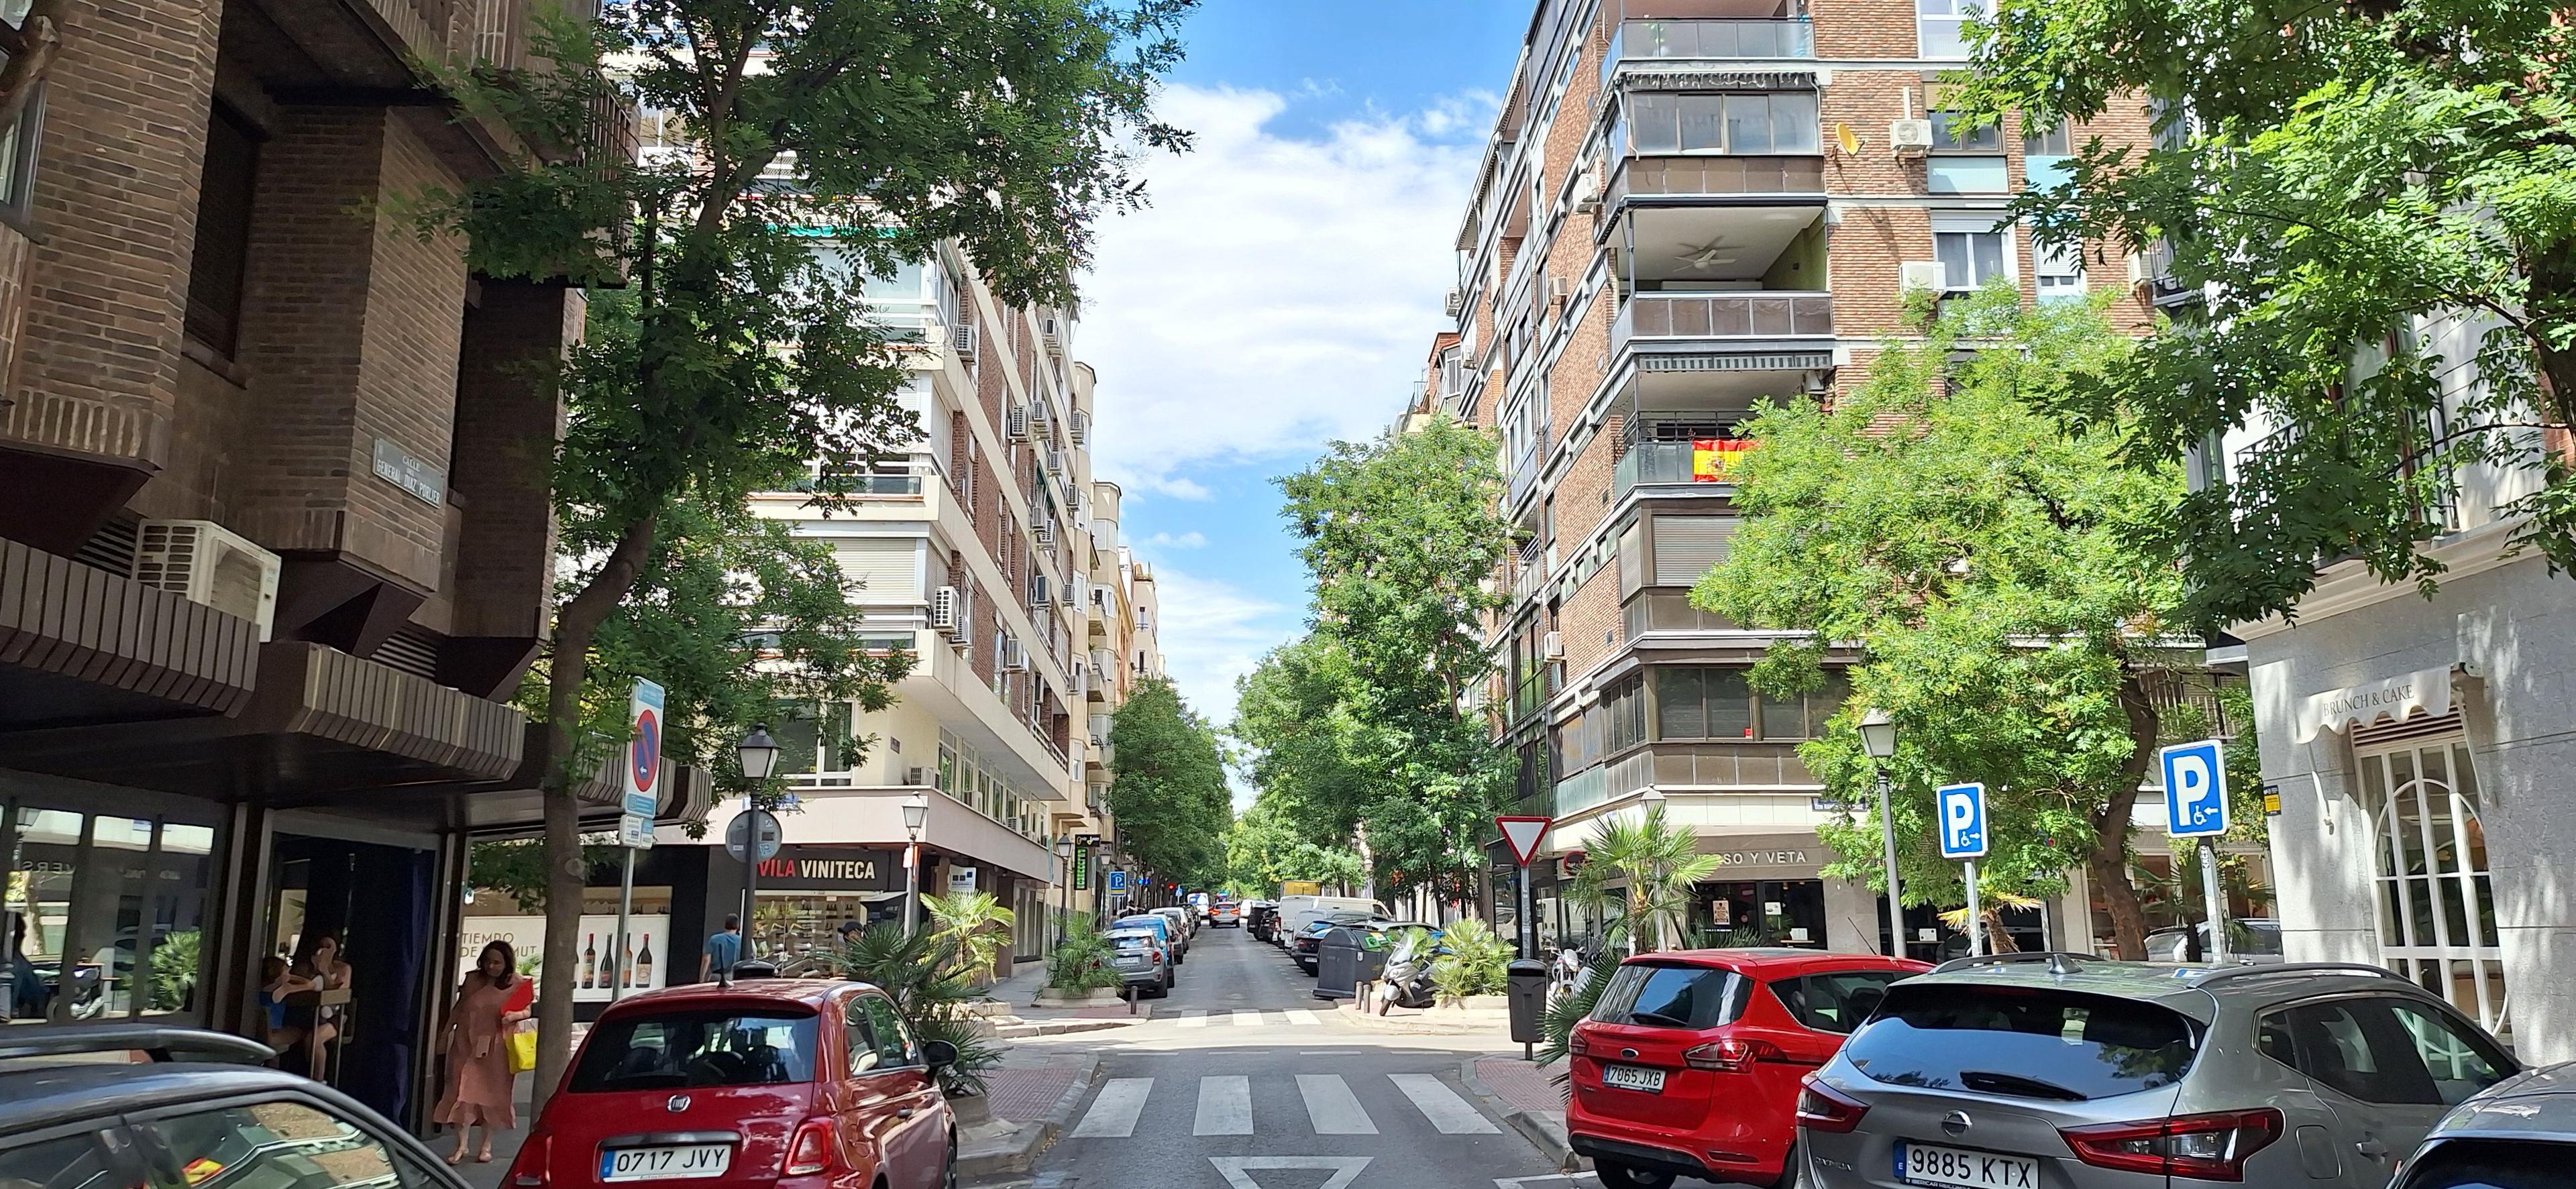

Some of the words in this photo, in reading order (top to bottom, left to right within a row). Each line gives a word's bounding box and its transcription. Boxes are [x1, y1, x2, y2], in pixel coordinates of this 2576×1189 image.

[402, 455, 421, 472] CALLE
[376, 459, 401, 484] GENERAL
[419, 482, 441, 506] PORLIER
[2323, 693, 2368, 716] BRUNCH
[2372, 692, 2380, 705] &
[2383, 684, 2414, 703] CAKE
[2172, 756, 2210, 826] P
[1947, 793, 1974, 848] P
[757, 858, 796, 877] VILA
[801, 859, 875, 879] VINITECA
[1750, 852, 1759, 864] Y
[1766, 851, 1806, 864] VETA
[462, 932, 515, 944] TIEMPO
[461, 946, 478, 958] DE
[1610, 1067, 1638, 1084] 7065
[1640, 1071, 1661, 1086] JXB
[617, 1151, 674, 1172] 0717
[682, 1149, 725, 1168] JVY
[1912, 1149, 1971, 1180] 9885
[1982, 1157, 2031, 1189] KTX
